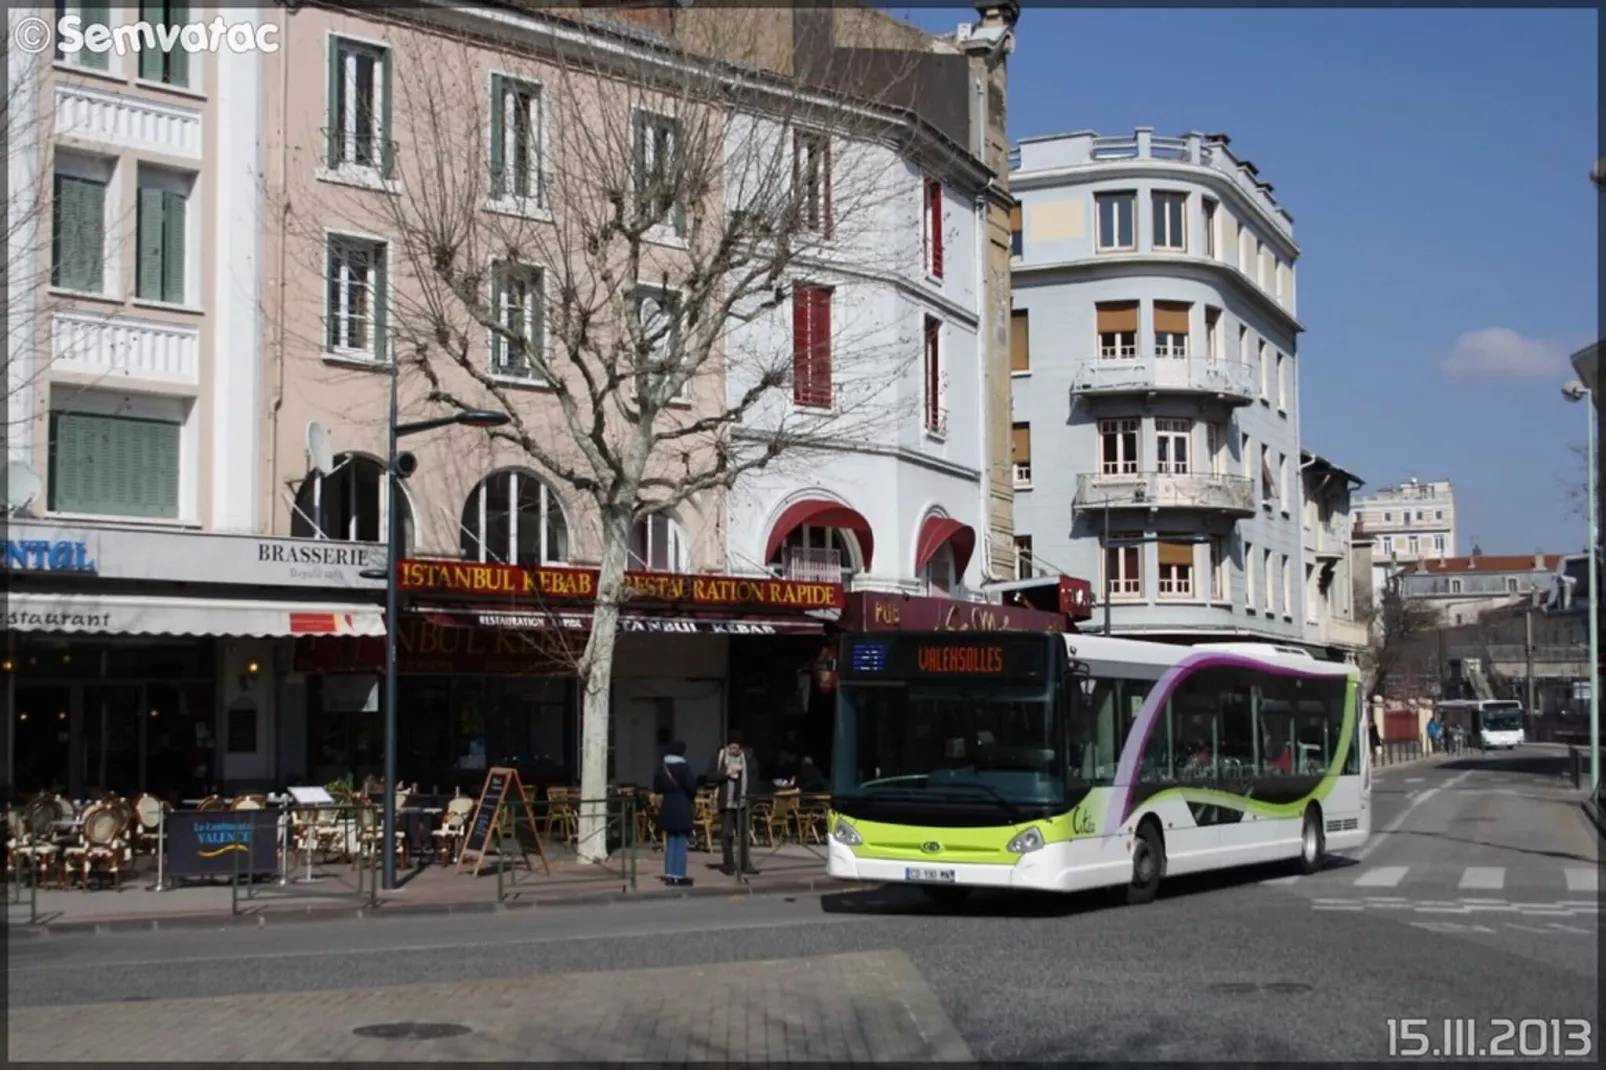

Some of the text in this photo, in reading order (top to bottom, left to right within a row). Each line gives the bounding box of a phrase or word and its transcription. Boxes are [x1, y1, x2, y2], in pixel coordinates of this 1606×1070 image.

[258, 543, 369, 567] BRASSERIE
[402, 563, 591, 595] ISTANBUL KEBAB
[769, 583, 836, 605] RAPIDE
[0, 611, 110, 627] staurant
[479, 615, 545, 629] RESTAURATION
[615, 619, 776, 635] STANBUL KEBAB
